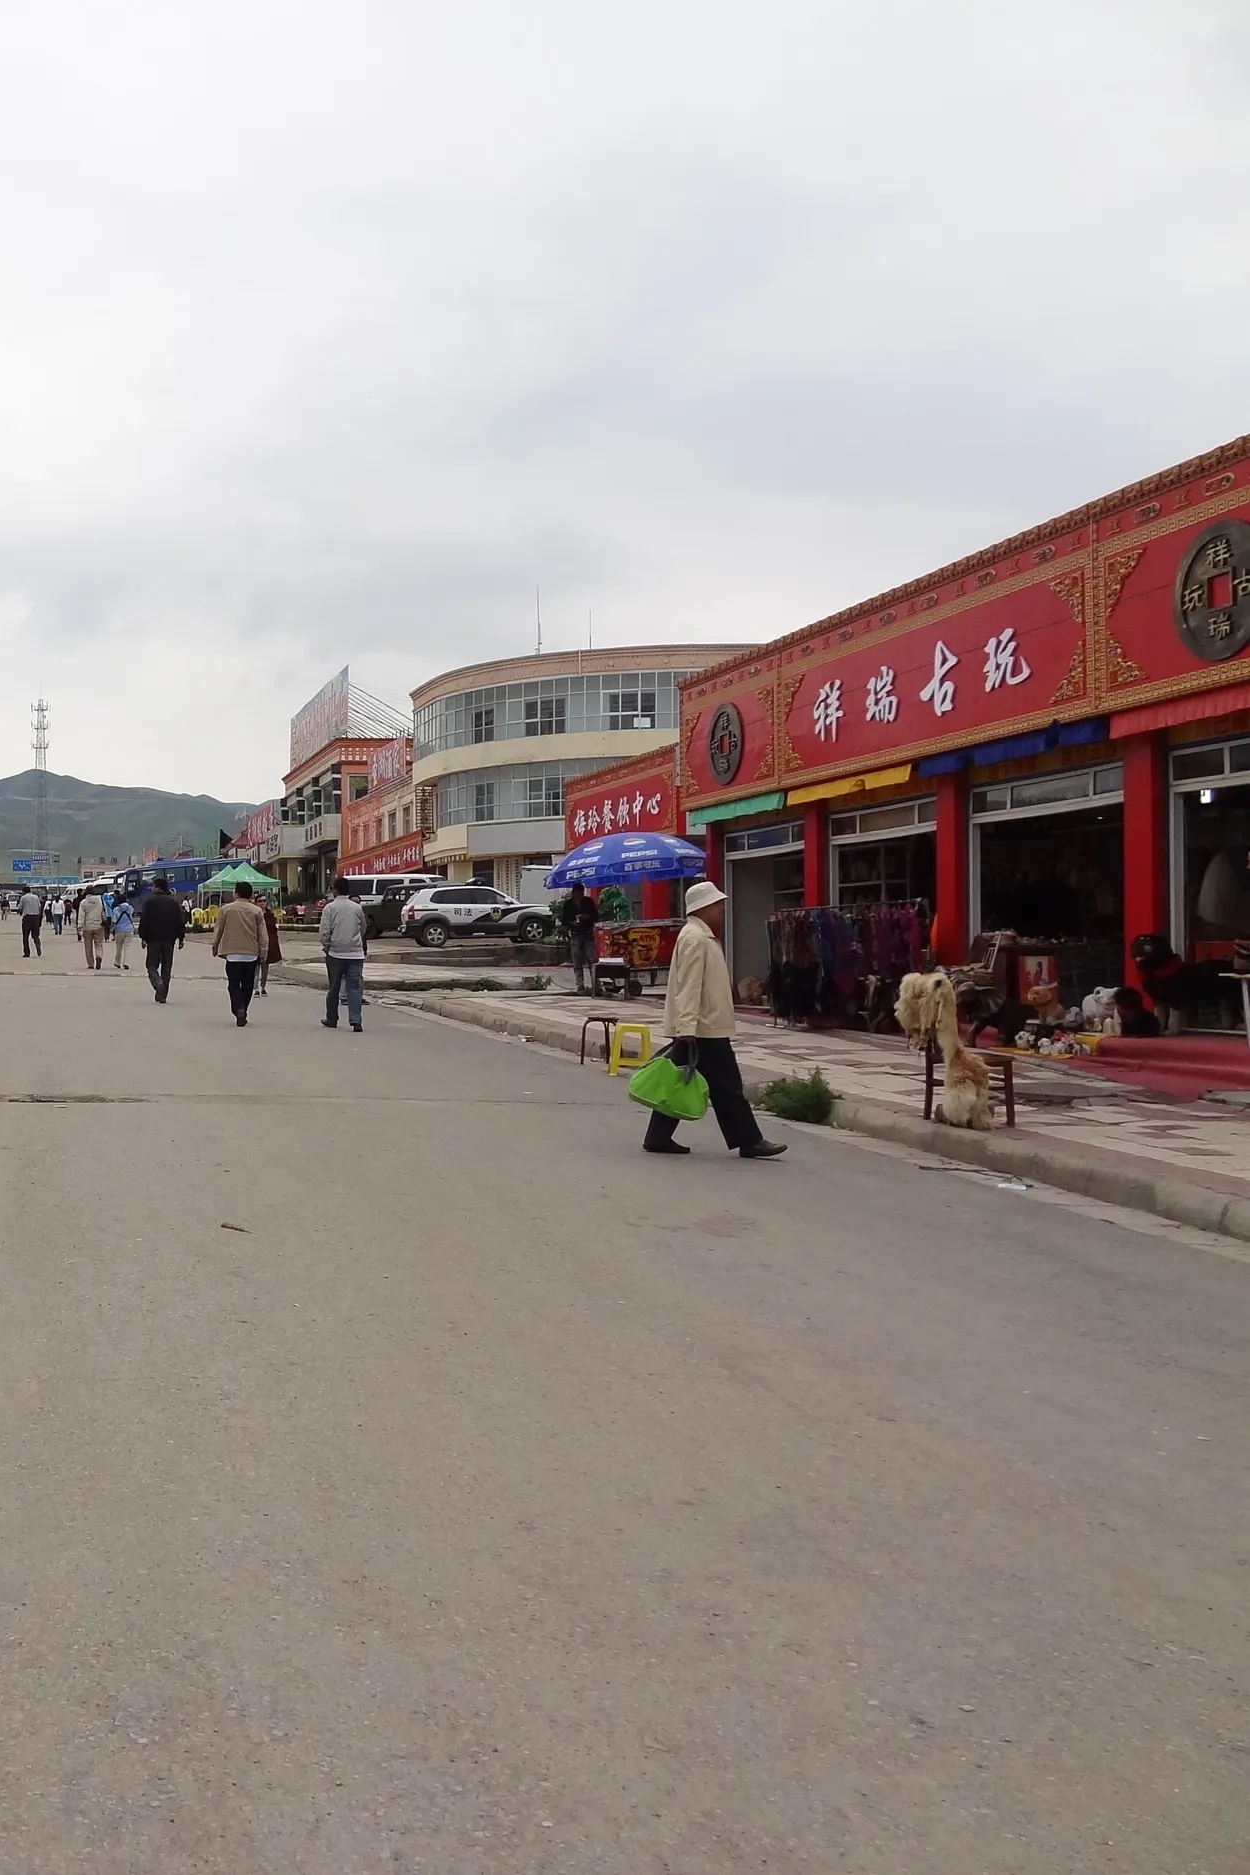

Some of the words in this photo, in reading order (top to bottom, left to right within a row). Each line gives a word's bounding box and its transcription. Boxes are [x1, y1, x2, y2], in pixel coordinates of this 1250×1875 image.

[1206, 539, 1231, 568] 祥
[1233, 568, 1250, 596] 古
[1183, 584, 1204, 611] 玩
[1208, 612, 1231, 640] 瑞
[813, 627, 1031, 743] 祥瑞古玩
[621, 849, 658, 859] PEPSI
[566, 866, 596, 880] PEPSI
[454, 907, 472, 917] 司法
